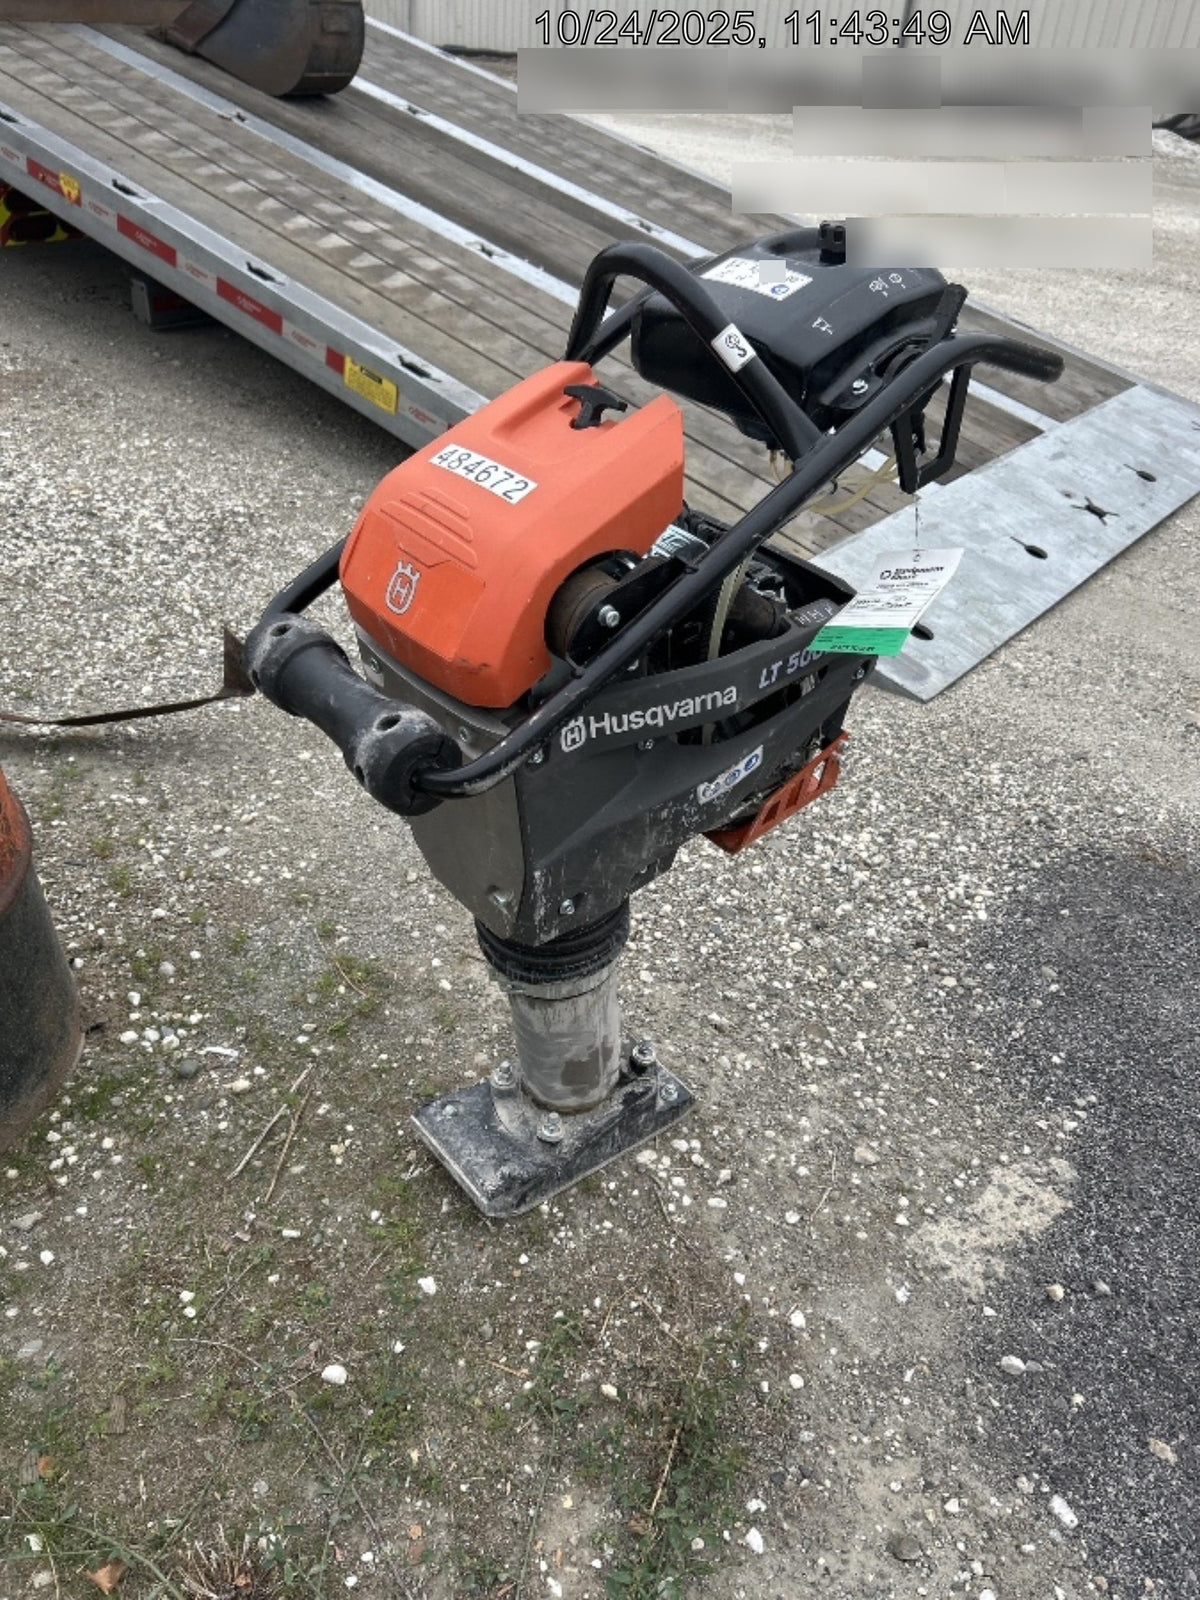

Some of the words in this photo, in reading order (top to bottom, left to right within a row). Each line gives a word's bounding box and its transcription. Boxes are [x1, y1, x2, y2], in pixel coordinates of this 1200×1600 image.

[437, 449, 529, 501] 484672
[758, 660, 784, 689] LT
[588, 685, 738, 739] Husqvarna
